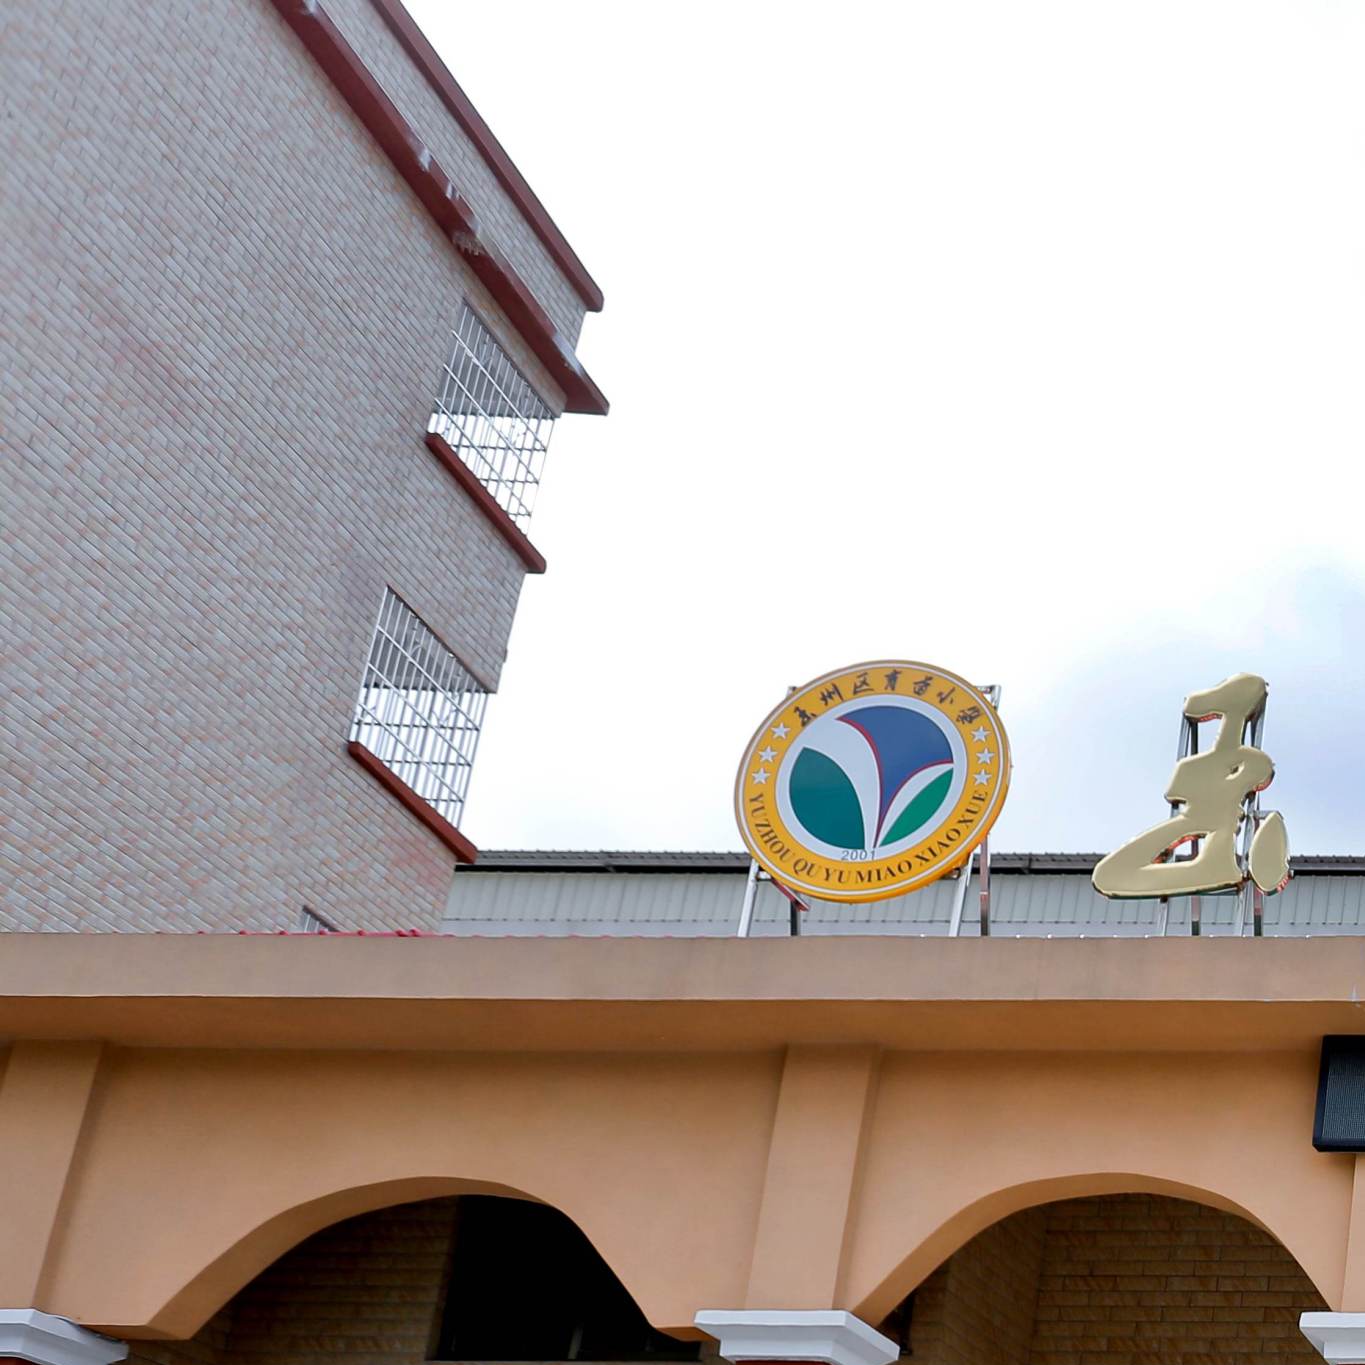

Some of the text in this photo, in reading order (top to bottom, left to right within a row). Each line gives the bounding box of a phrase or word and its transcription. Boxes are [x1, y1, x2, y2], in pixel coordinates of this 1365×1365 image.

[841, 850, 877, 862] 2001
[855, 860, 912, 883] MIAO
[914, 828, 962, 866] XIAO
[959, 790, 989, 830] XUE
